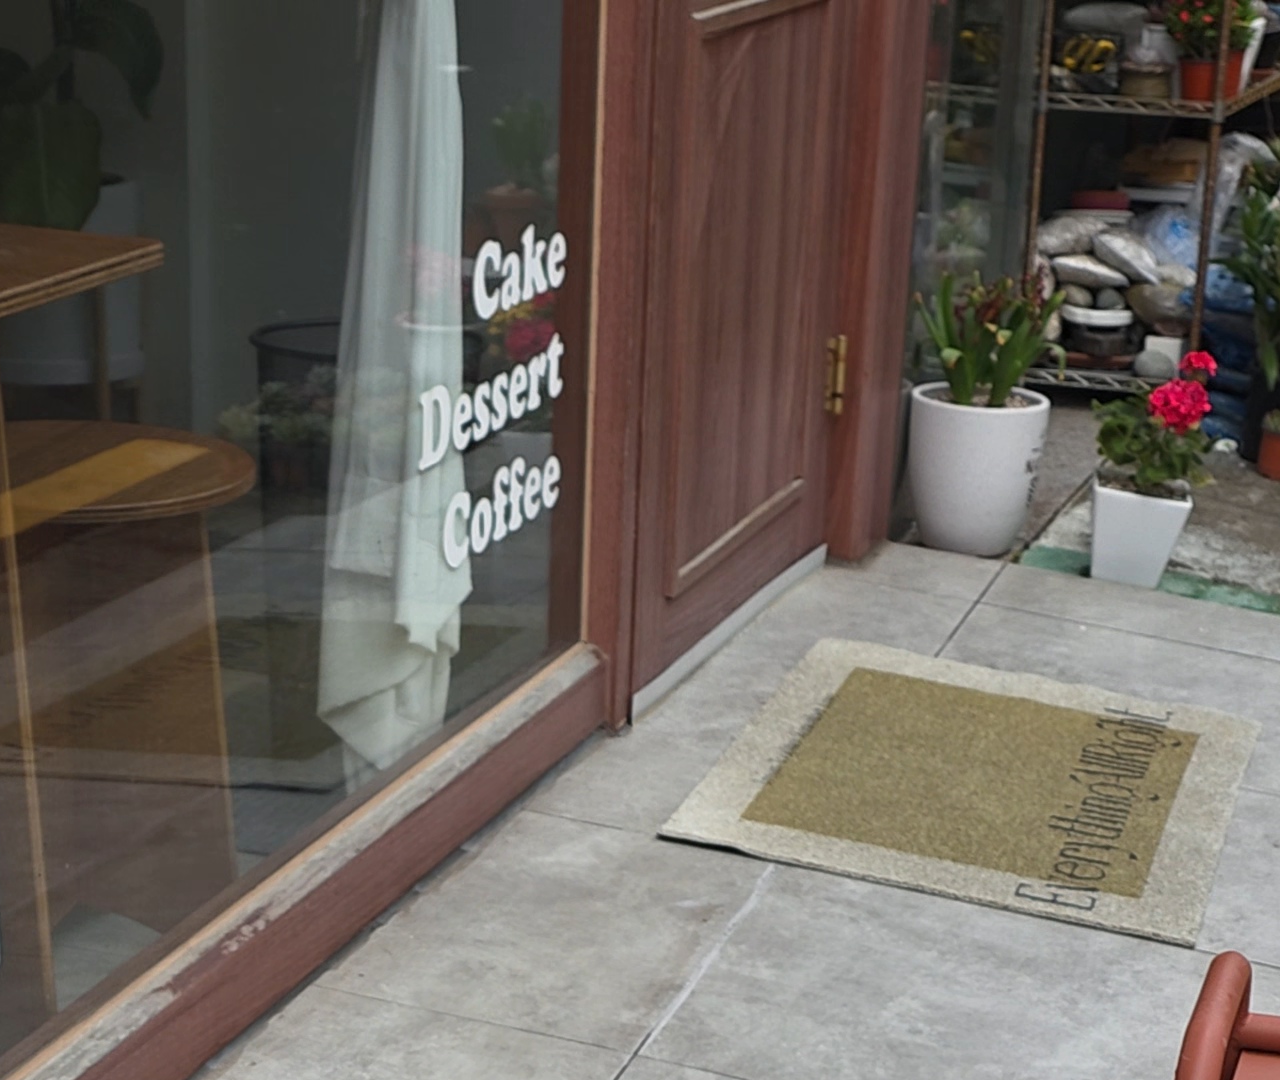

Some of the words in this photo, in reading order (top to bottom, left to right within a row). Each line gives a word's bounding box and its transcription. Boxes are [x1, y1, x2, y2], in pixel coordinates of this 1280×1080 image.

[473, 224, 567, 319] Cake
[419, 332, 564, 471] Dessert
[443, 455, 561, 568] Coffee
